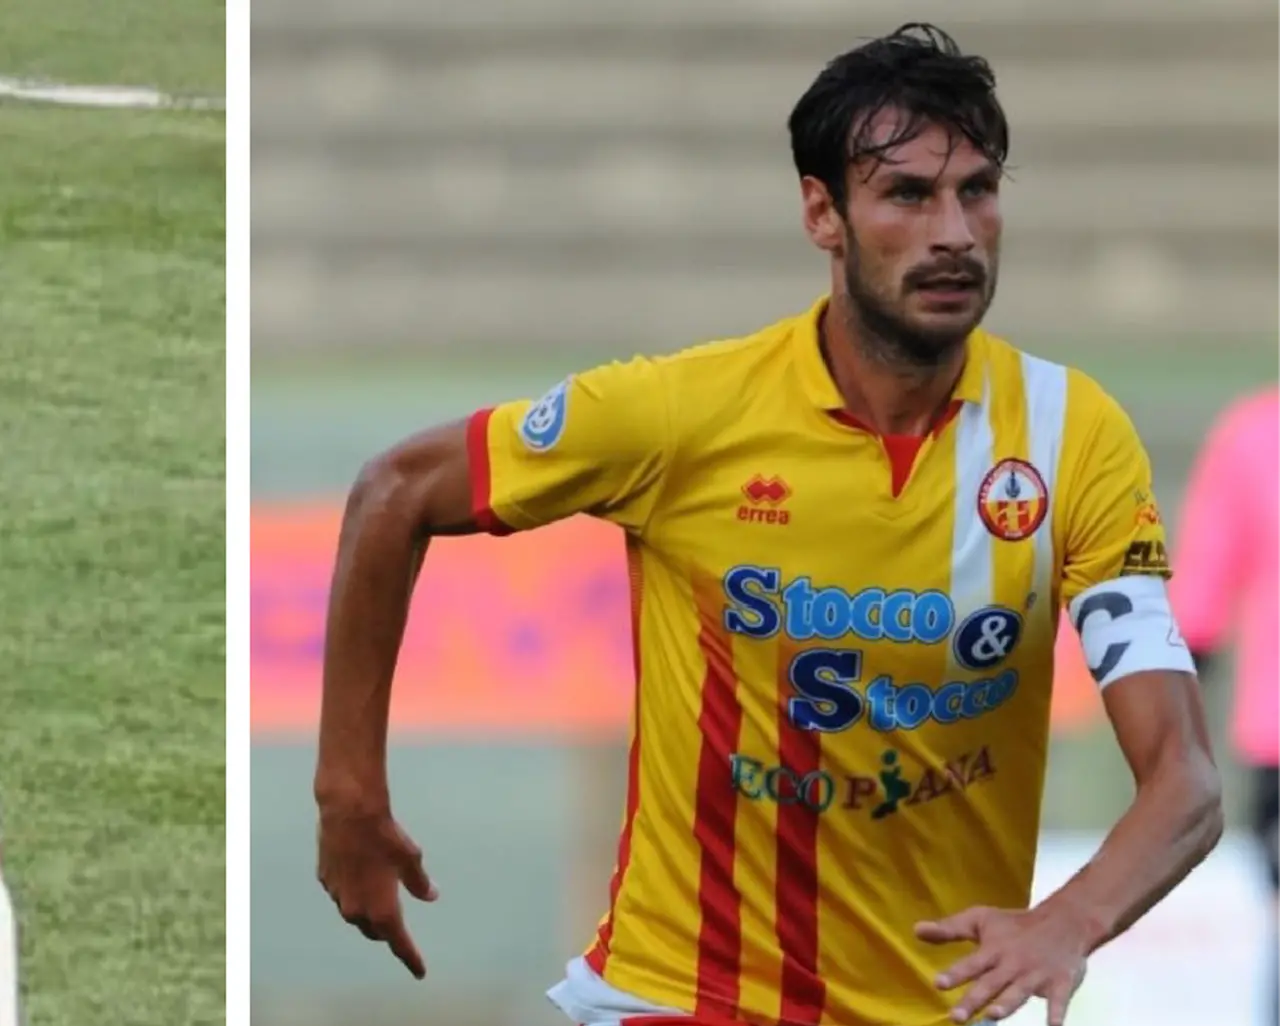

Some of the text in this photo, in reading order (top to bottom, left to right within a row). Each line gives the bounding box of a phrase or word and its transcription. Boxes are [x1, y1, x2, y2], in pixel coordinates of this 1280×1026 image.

[724, 565, 1014, 662] Stocco &
[789, 648, 1020, 732] Stocco
[730, 753, 835, 813] ECO
